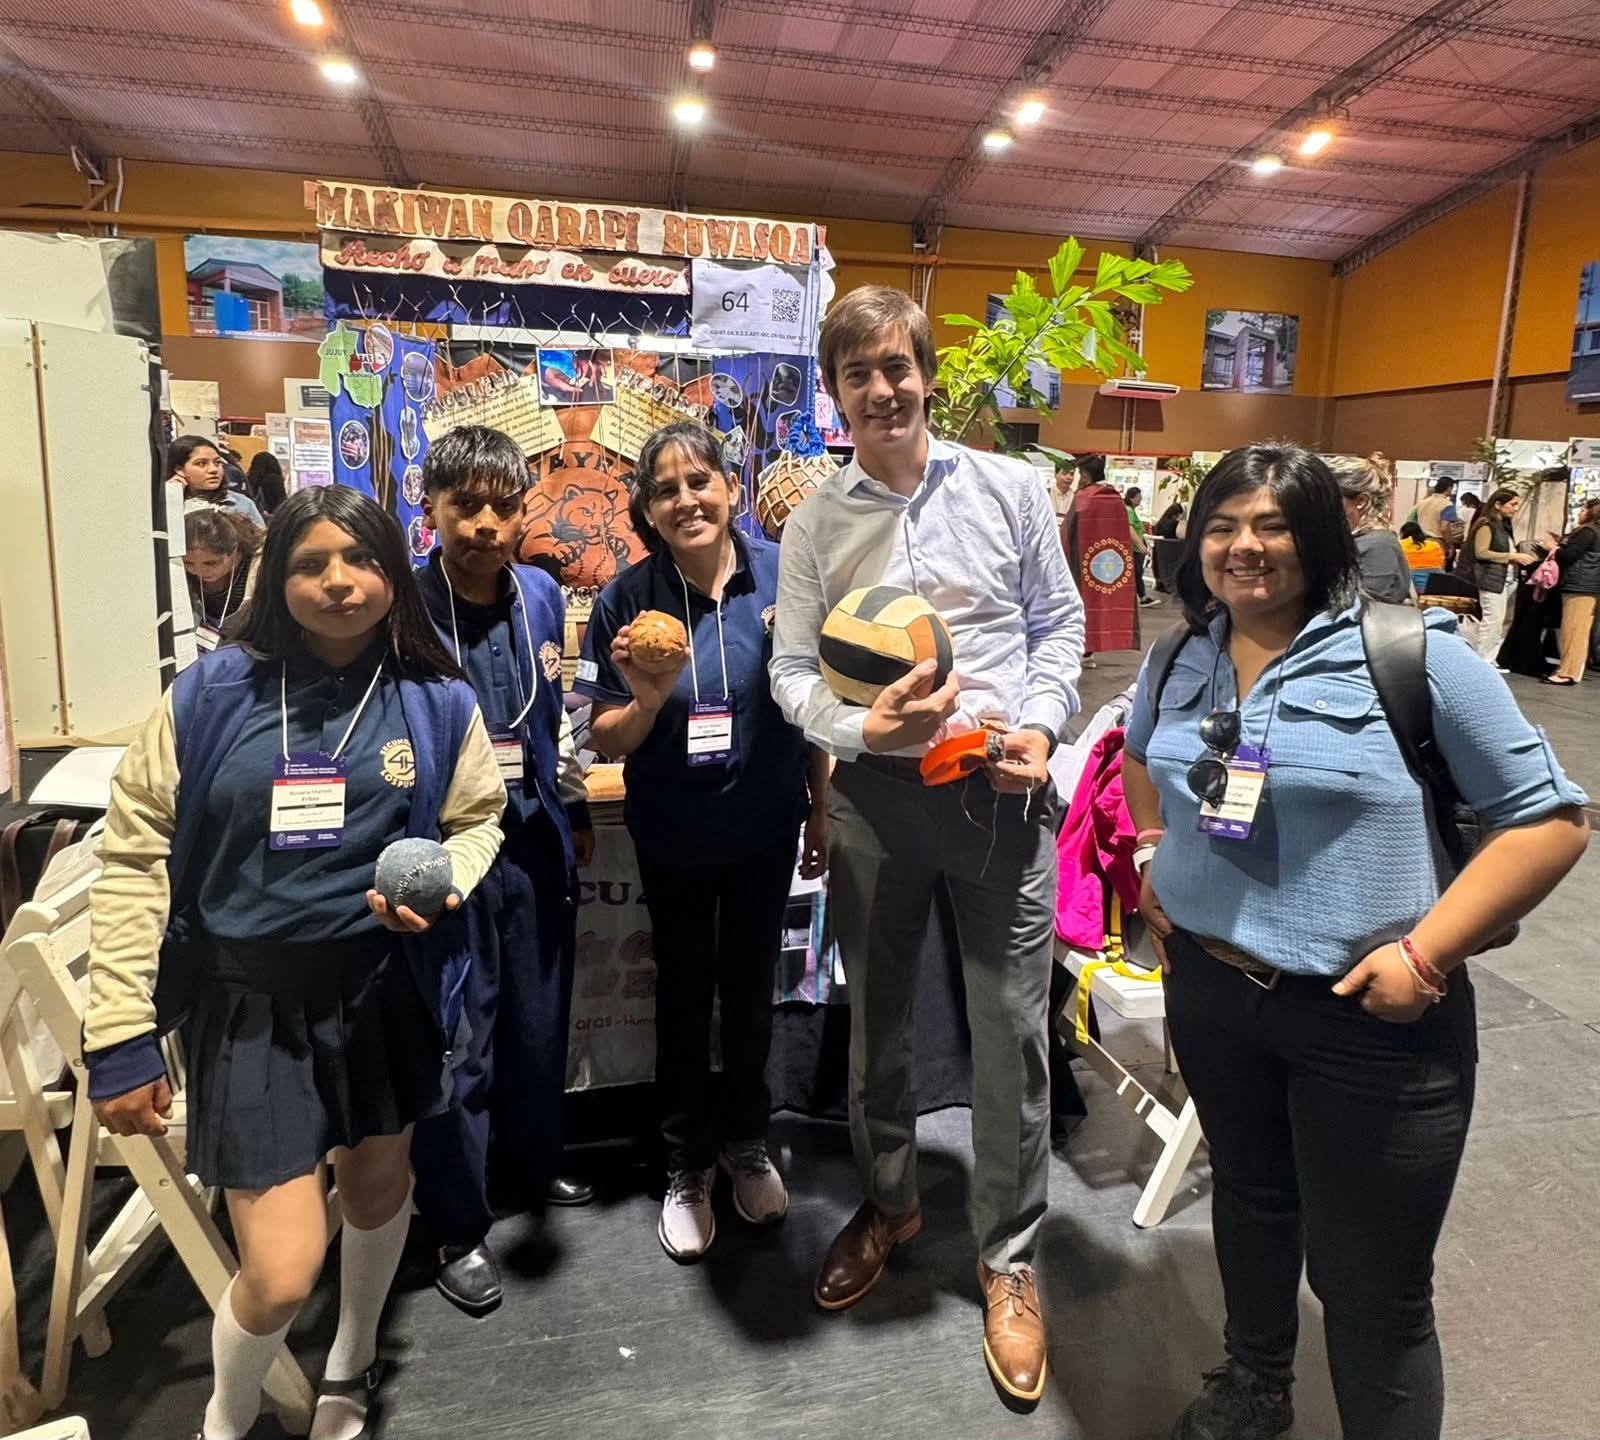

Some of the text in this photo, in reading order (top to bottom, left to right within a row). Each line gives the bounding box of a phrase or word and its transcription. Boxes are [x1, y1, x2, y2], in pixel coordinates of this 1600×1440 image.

[316, 186, 811, 264] MAKIWAN QARAPI RUWASQA
[561, 263, 594, 282] en
[721, 291, 750, 312] 64
[326, 347, 347, 357] JUJUY
[623, 1015, 656, 1027] Hum
